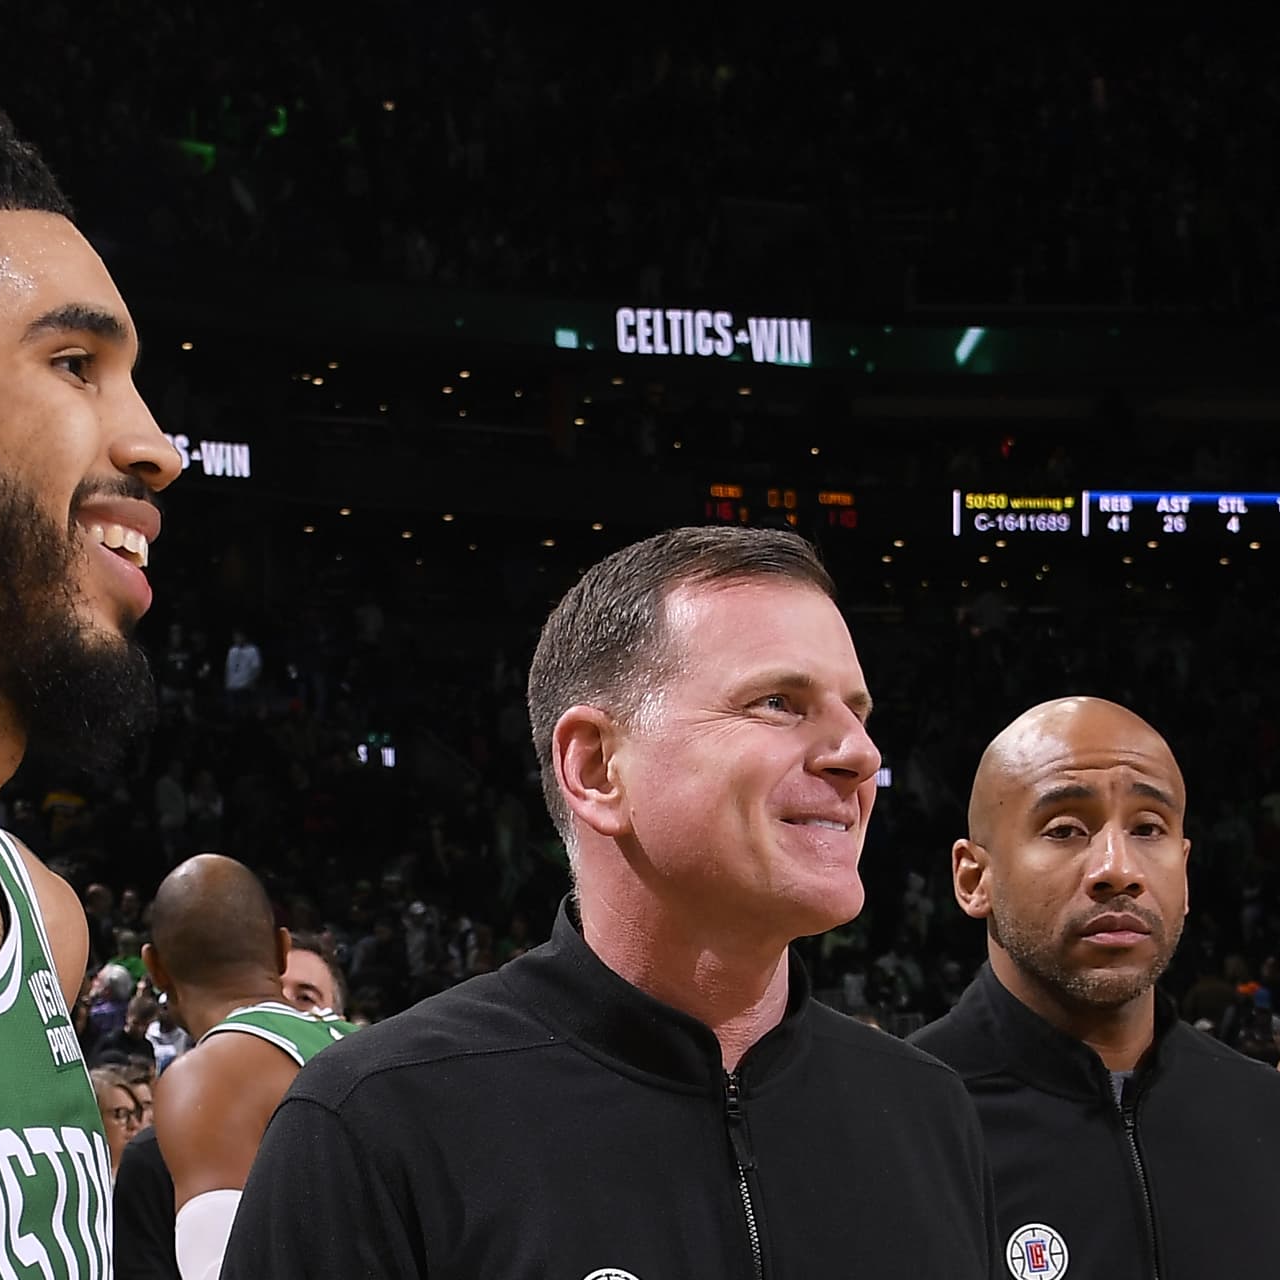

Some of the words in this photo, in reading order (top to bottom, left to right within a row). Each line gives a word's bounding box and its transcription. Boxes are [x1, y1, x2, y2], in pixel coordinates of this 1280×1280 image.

[615, 306, 735, 357] CELTICS
[747, 317, 813, 364] WIN
[199, 439, 251, 478] WIN
[964, 492, 1008, 510] 50/50
[1009, 497, 1064, 512] winning
[1098, 494, 1134, 513] REB
[1155, 495, 1192, 514] AST
[1217, 496, 1249, 514] STL
[973, 512, 1071, 532] C-1641689
[1106, 514, 1131, 533] 41
[1161, 513, 1188, 533] 26
[1225, 514, 1241, 534] 4
[27, 969, 67, 1025] VIST
